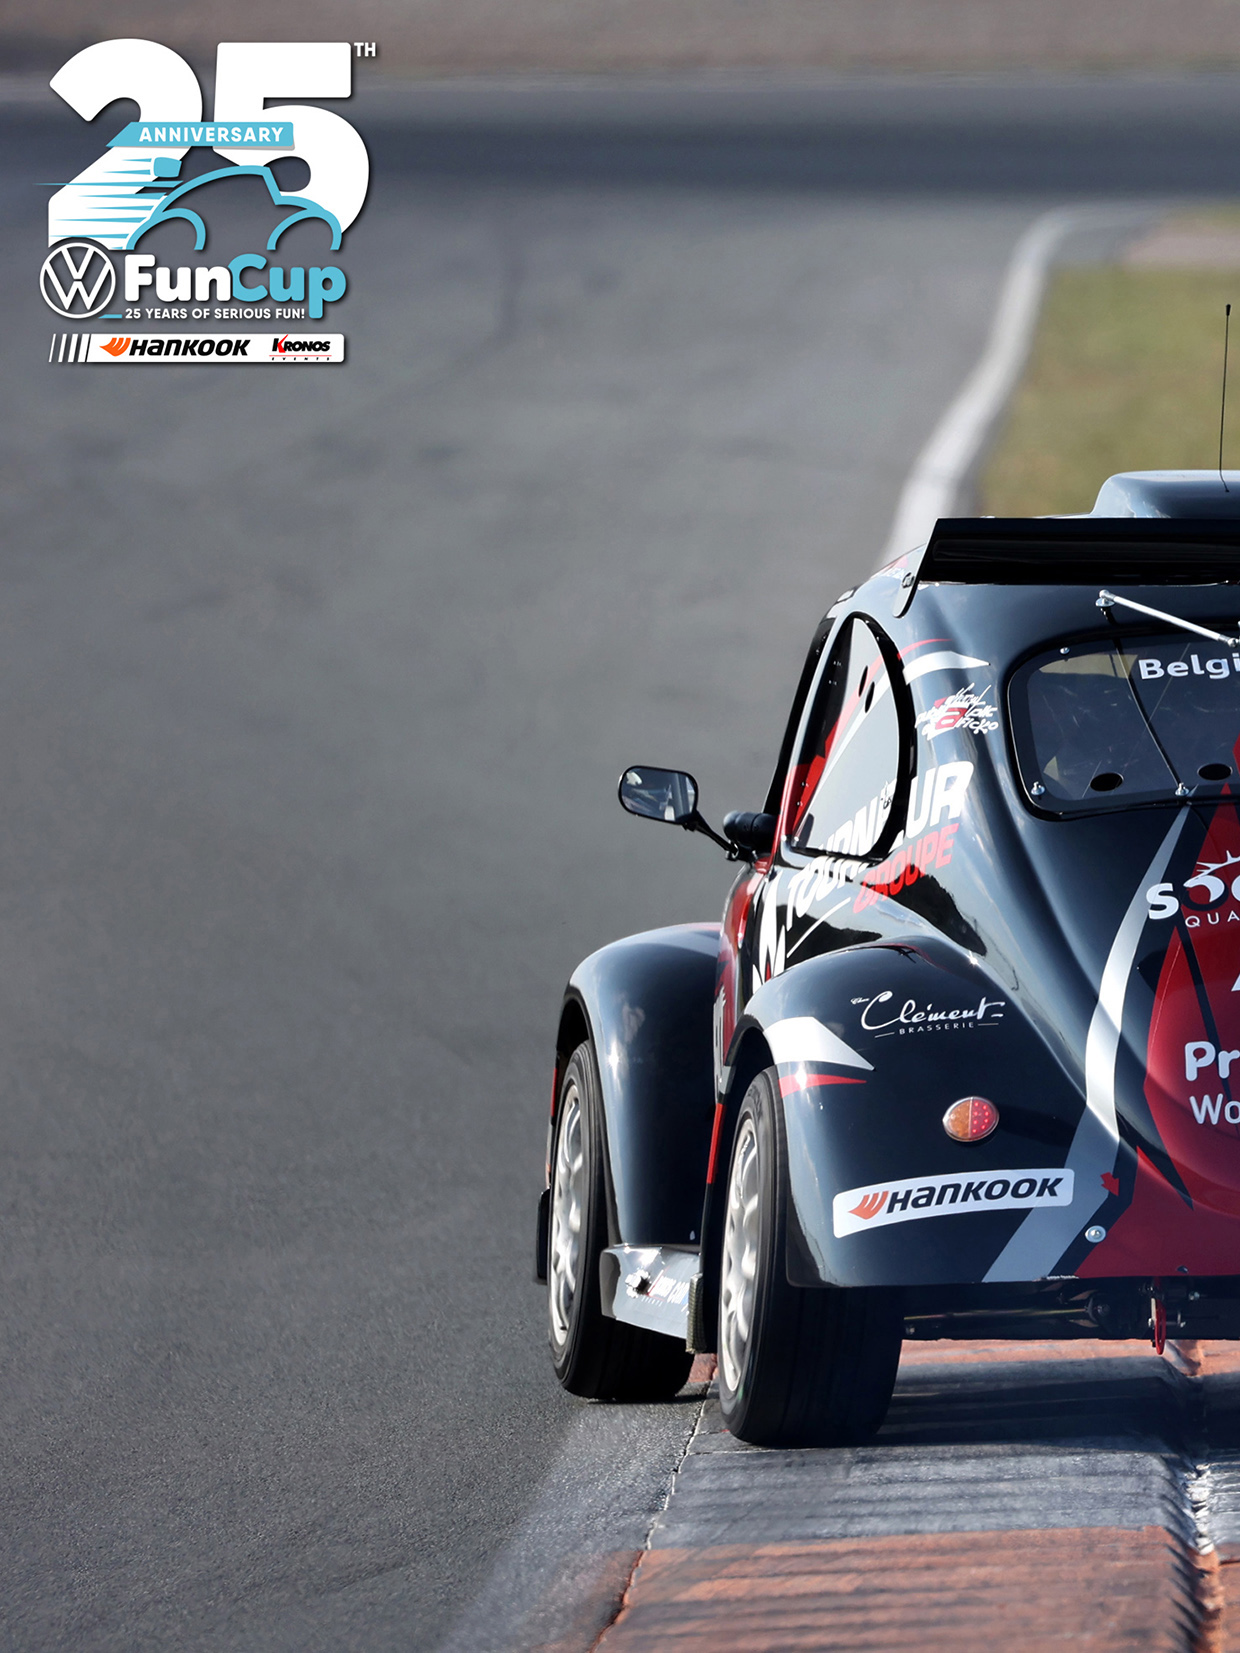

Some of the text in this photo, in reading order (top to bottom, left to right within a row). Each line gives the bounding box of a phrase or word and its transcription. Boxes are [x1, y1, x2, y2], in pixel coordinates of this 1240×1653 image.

[852, 823, 960, 914] GROUPE
[860, 990, 1006, 1031] Clément
[899, 1022, 975, 1036] BRASSERIE
